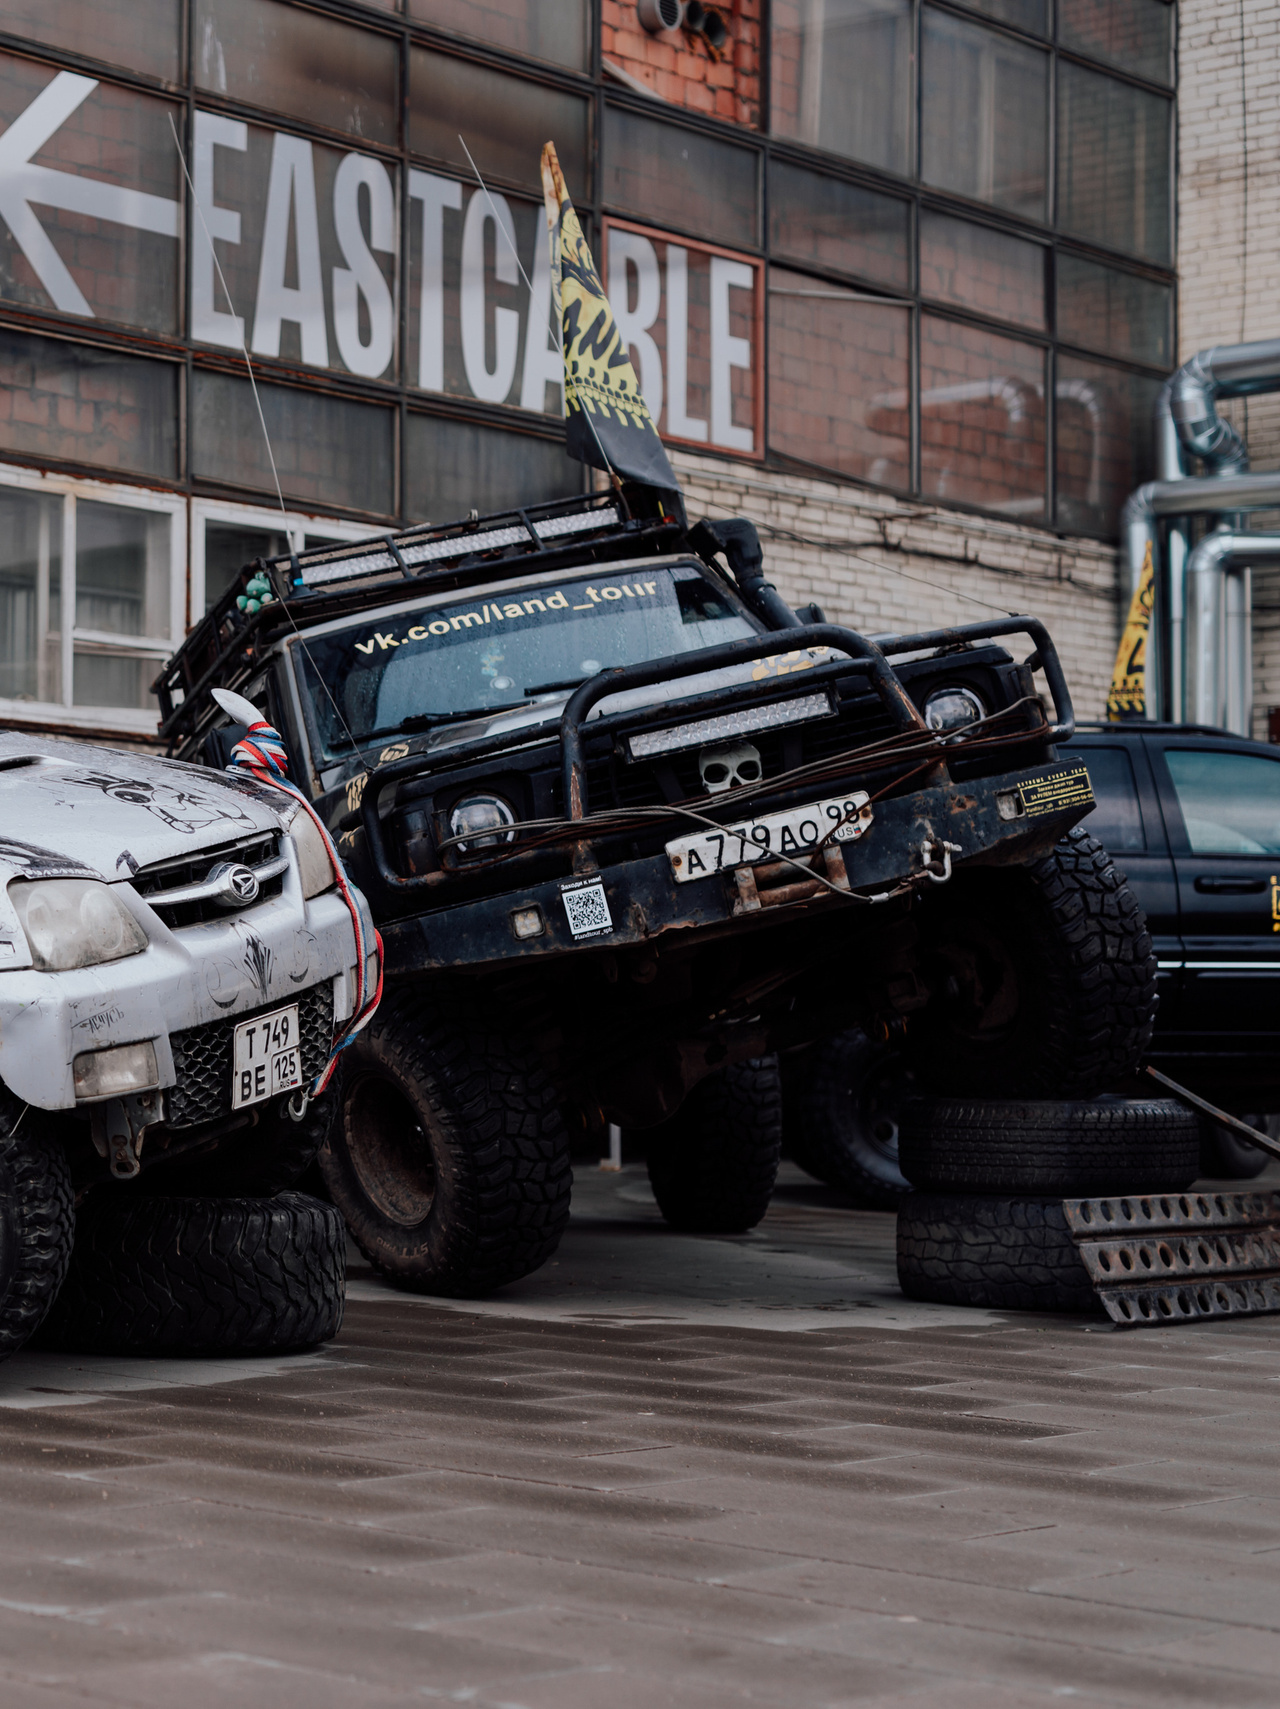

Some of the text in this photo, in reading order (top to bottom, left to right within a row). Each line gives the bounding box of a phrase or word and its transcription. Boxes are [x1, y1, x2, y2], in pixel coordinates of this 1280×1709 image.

[354, 581, 658, 656] vk.com/land_tour
[826, 800, 860, 829] 98
[263, 1015, 289, 1055] 749
[275, 1052, 296, 1081] 125
[280, 1079, 291, 1088] RUS
[398, 1242, 429, 1258] STT
